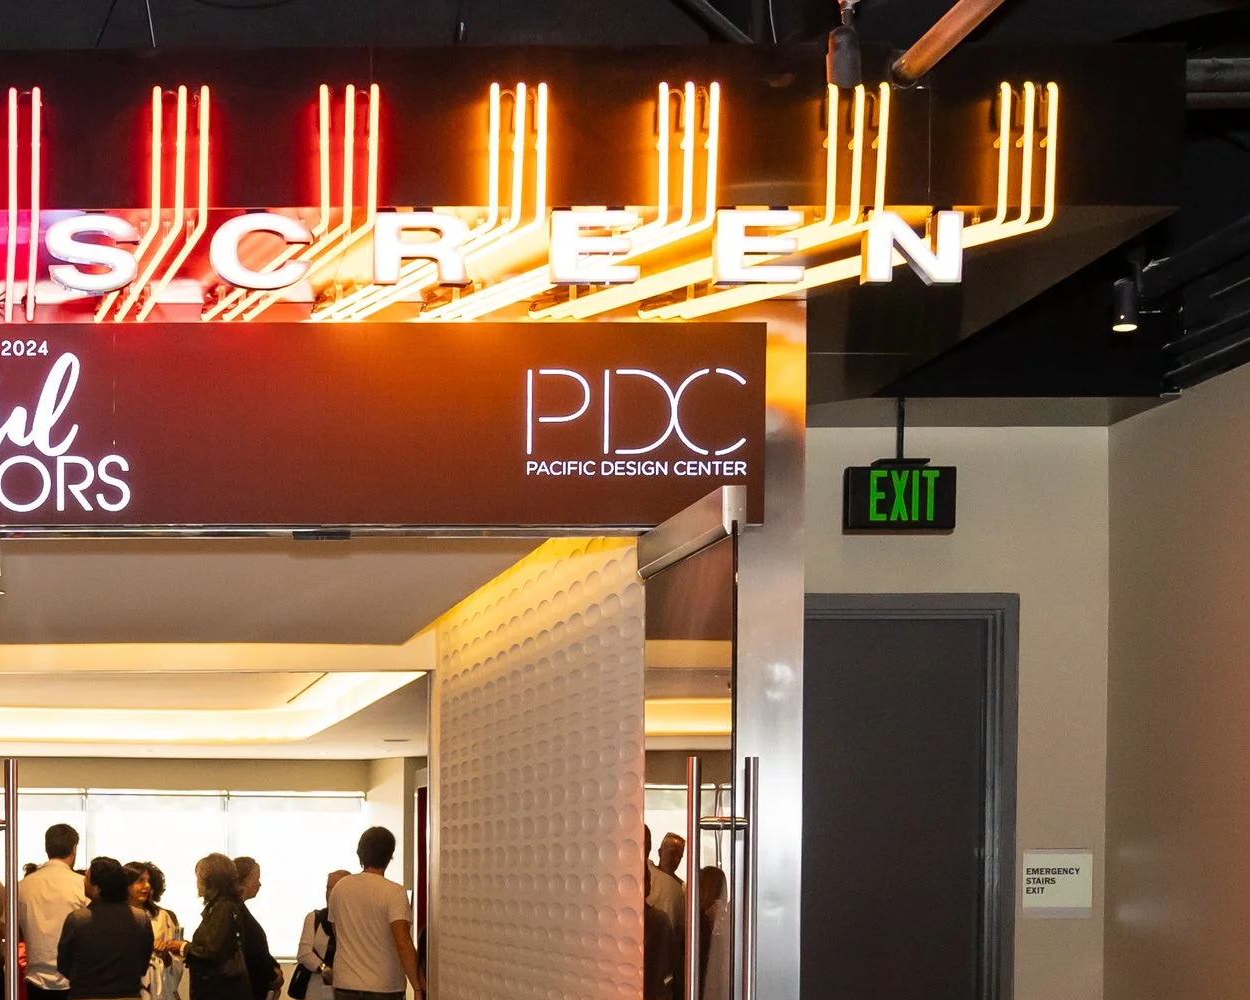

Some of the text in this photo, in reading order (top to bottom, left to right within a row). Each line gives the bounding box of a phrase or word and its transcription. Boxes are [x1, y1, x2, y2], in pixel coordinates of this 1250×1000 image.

[45, 209, 965, 294] SCREEN
[1, 340, 49, 357] 2024
[526, 368, 747, 456] PDC
[526, 460, 747, 476] PACIFIC DESIGN CENTER
[869, 469, 940, 521] EXIT
[1026, 867, 1080, 875] EMERGENCY
[1026, 877, 1056, 885] STAIRS
[1026, 886, 1045, 895] EXIT
